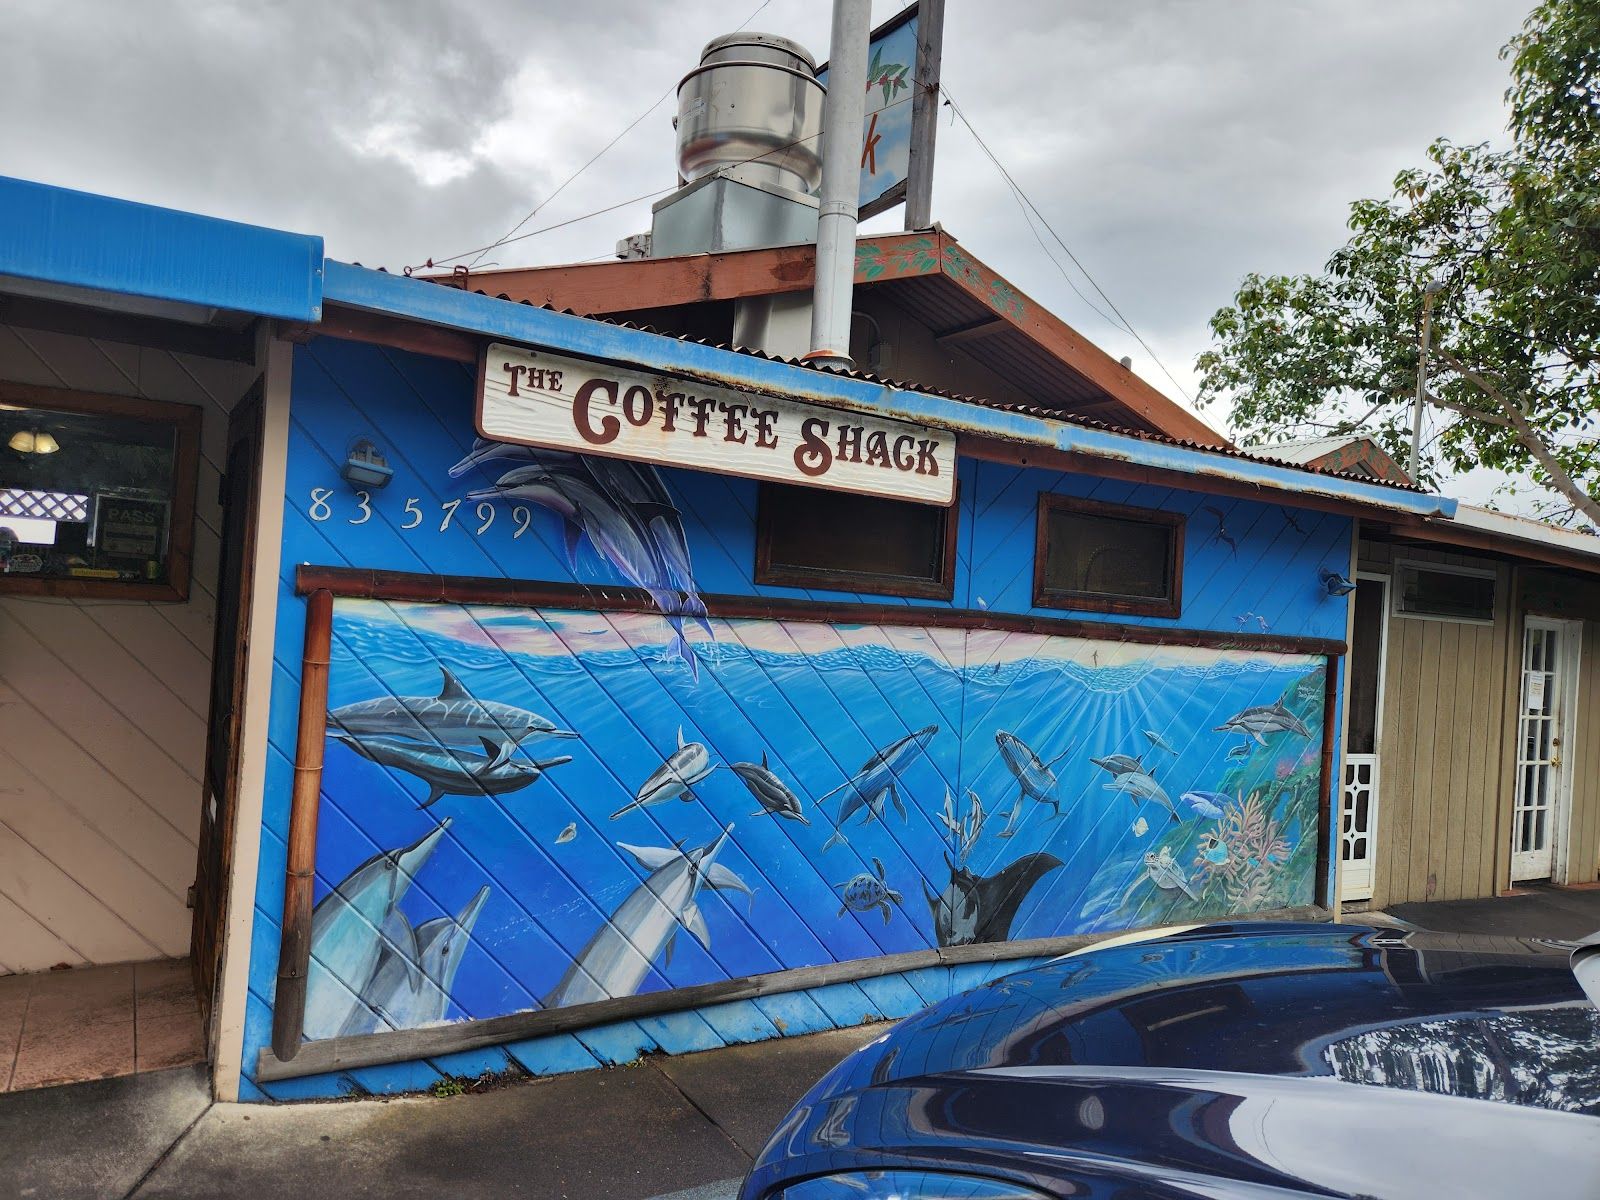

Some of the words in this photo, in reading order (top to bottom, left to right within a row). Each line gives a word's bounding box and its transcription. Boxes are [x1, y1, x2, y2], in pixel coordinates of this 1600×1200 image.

[503, 362, 563, 397] THE
[572, 379, 779, 450] COFFEE
[793, 417, 940, 477] SHACK
[108, 508, 155, 524] PASS
